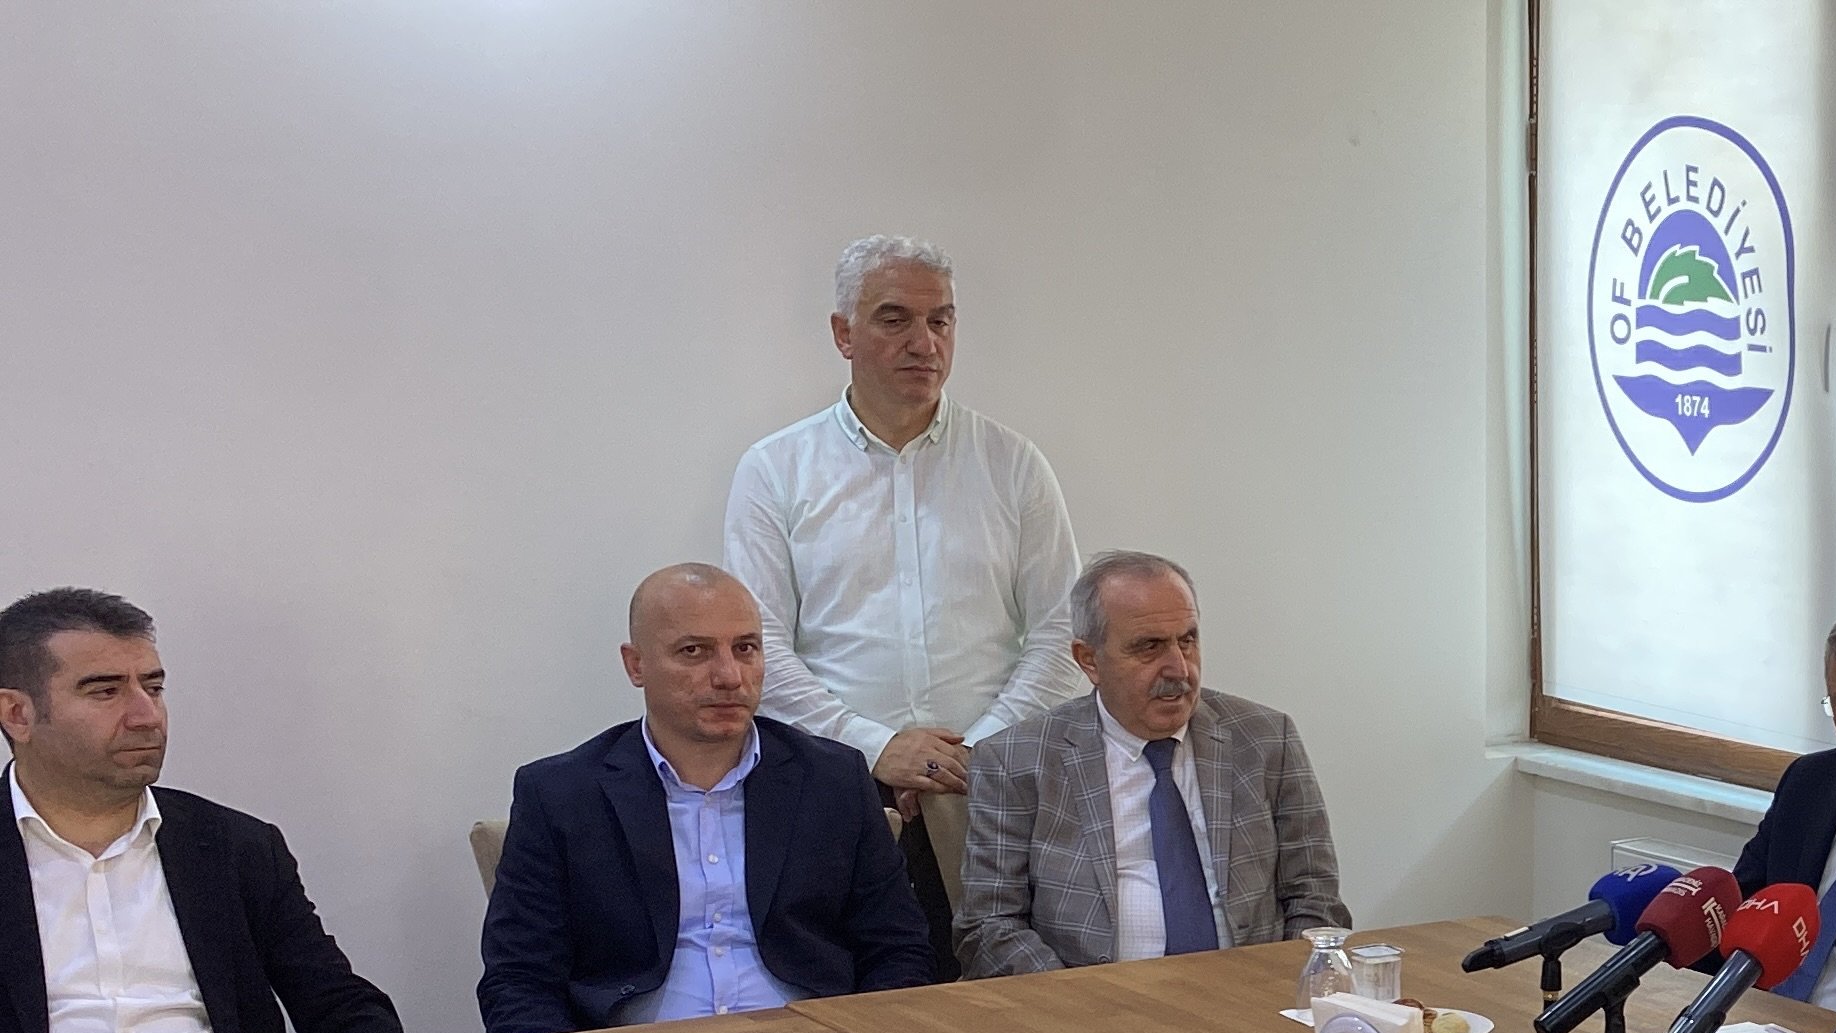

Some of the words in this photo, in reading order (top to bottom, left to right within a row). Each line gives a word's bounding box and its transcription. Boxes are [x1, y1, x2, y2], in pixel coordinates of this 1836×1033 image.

[1620, 163, 1773, 354] BELEDİYESİ
[1609, 277, 1633, 346] OF
[1674, 393, 1711, 419] 1874
